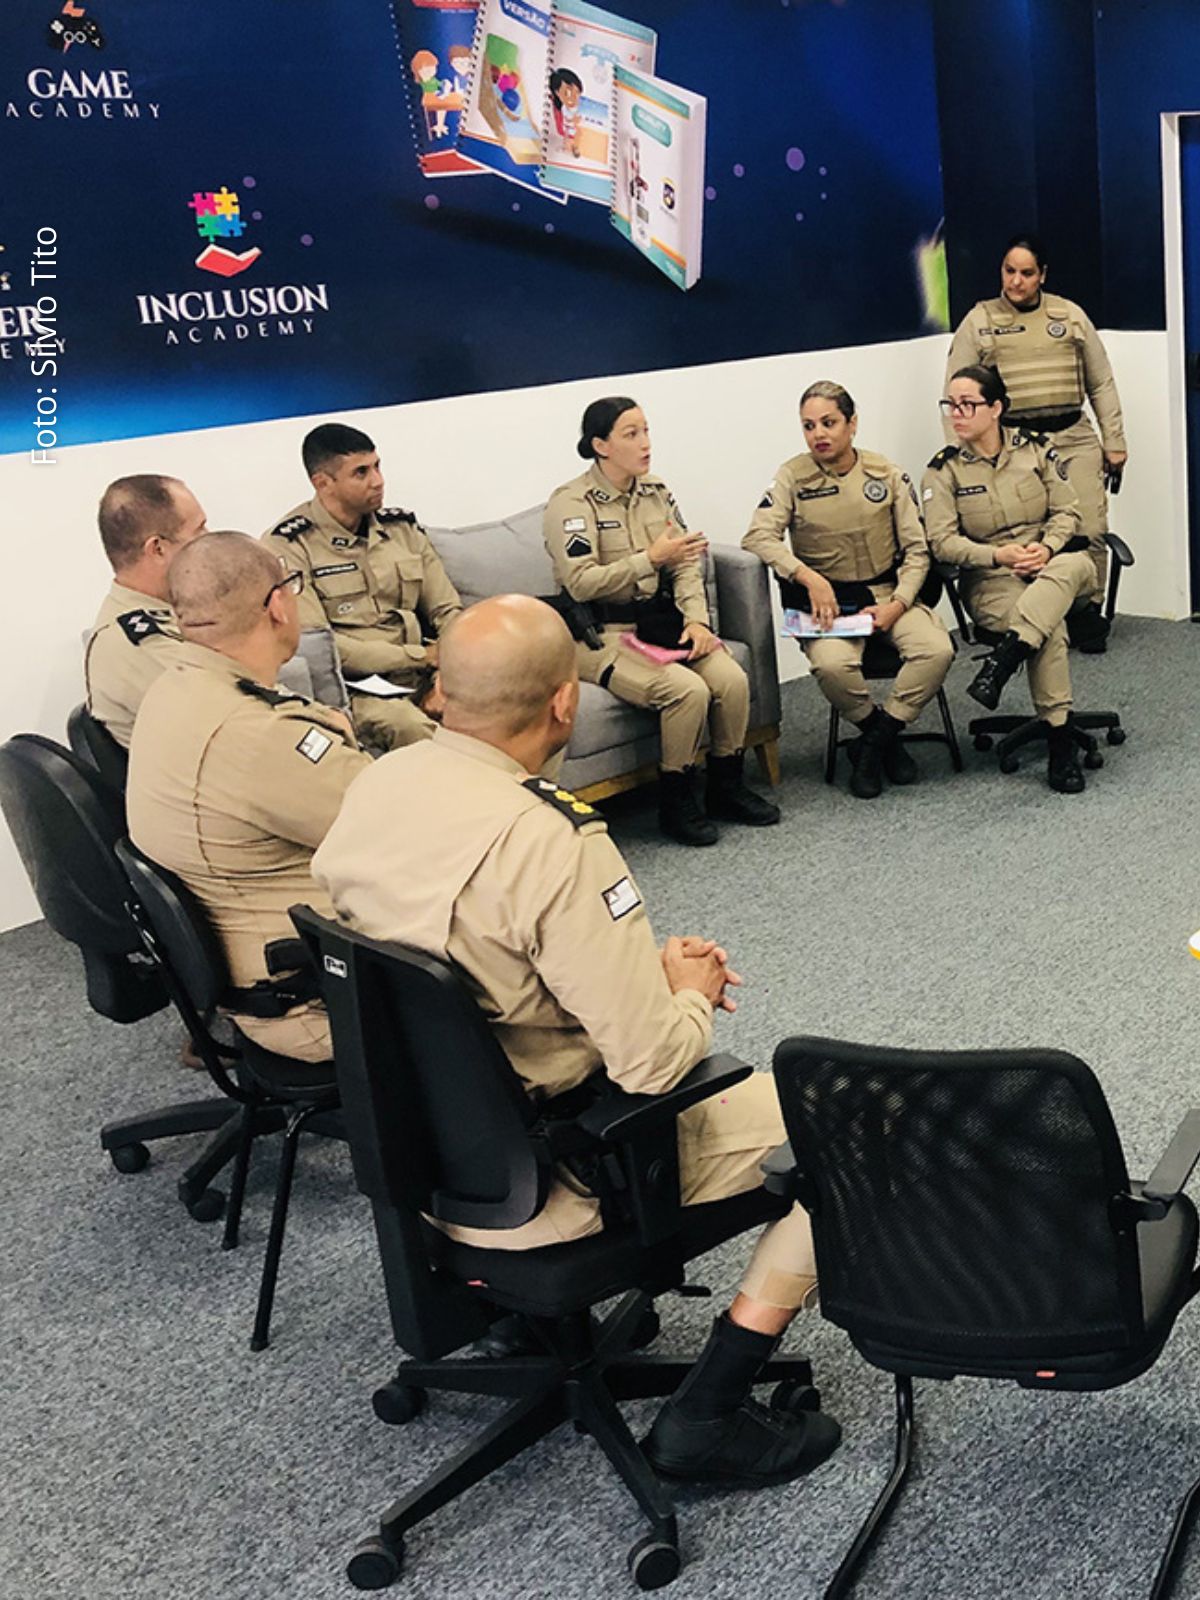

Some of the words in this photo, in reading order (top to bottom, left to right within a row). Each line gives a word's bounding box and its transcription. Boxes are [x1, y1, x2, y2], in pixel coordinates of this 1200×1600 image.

[27, 68, 133, 100] GAME
[6, 102, 160, 119] ACADEMY
[136, 284, 330, 325] INCLUSION
[165, 318, 314, 345] ACADEMY
